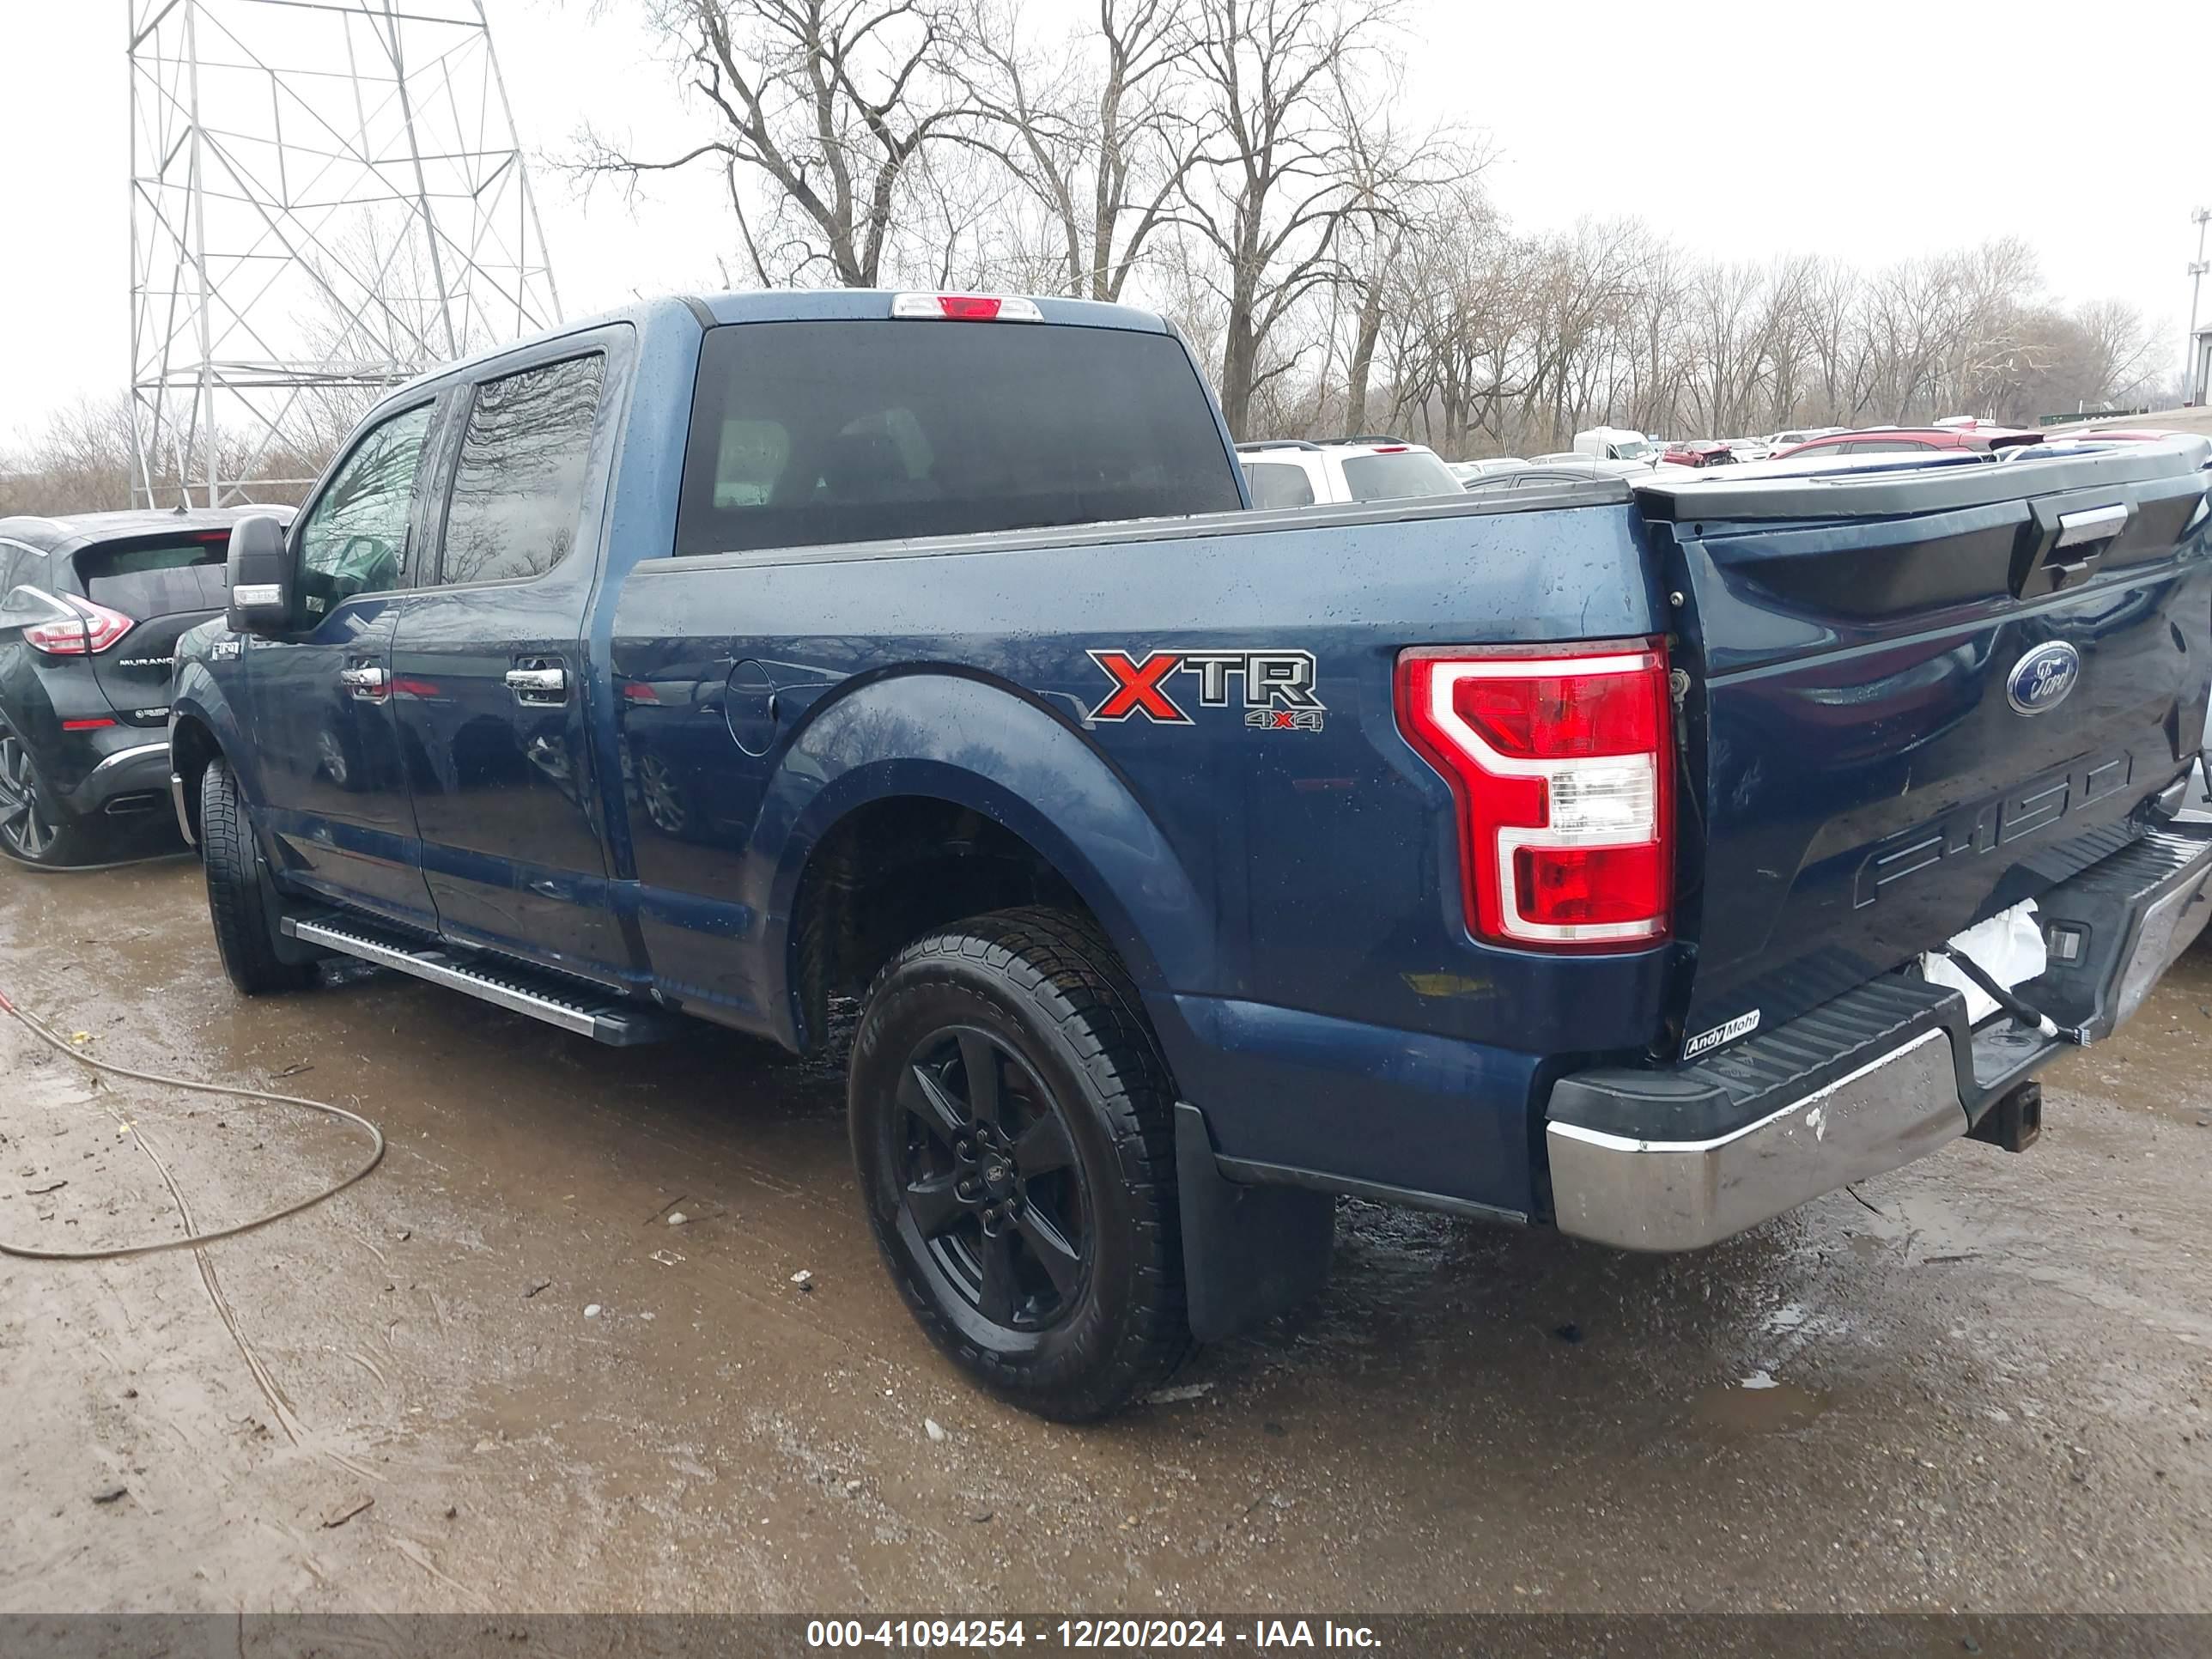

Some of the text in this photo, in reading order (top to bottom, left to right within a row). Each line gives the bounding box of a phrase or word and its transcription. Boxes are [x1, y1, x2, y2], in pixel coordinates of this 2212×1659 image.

[119, 657, 174, 666] MURANO
[1085, 650, 1328, 726] XTR
[1688, 1014, 1759, 1054] Andy Mohr
